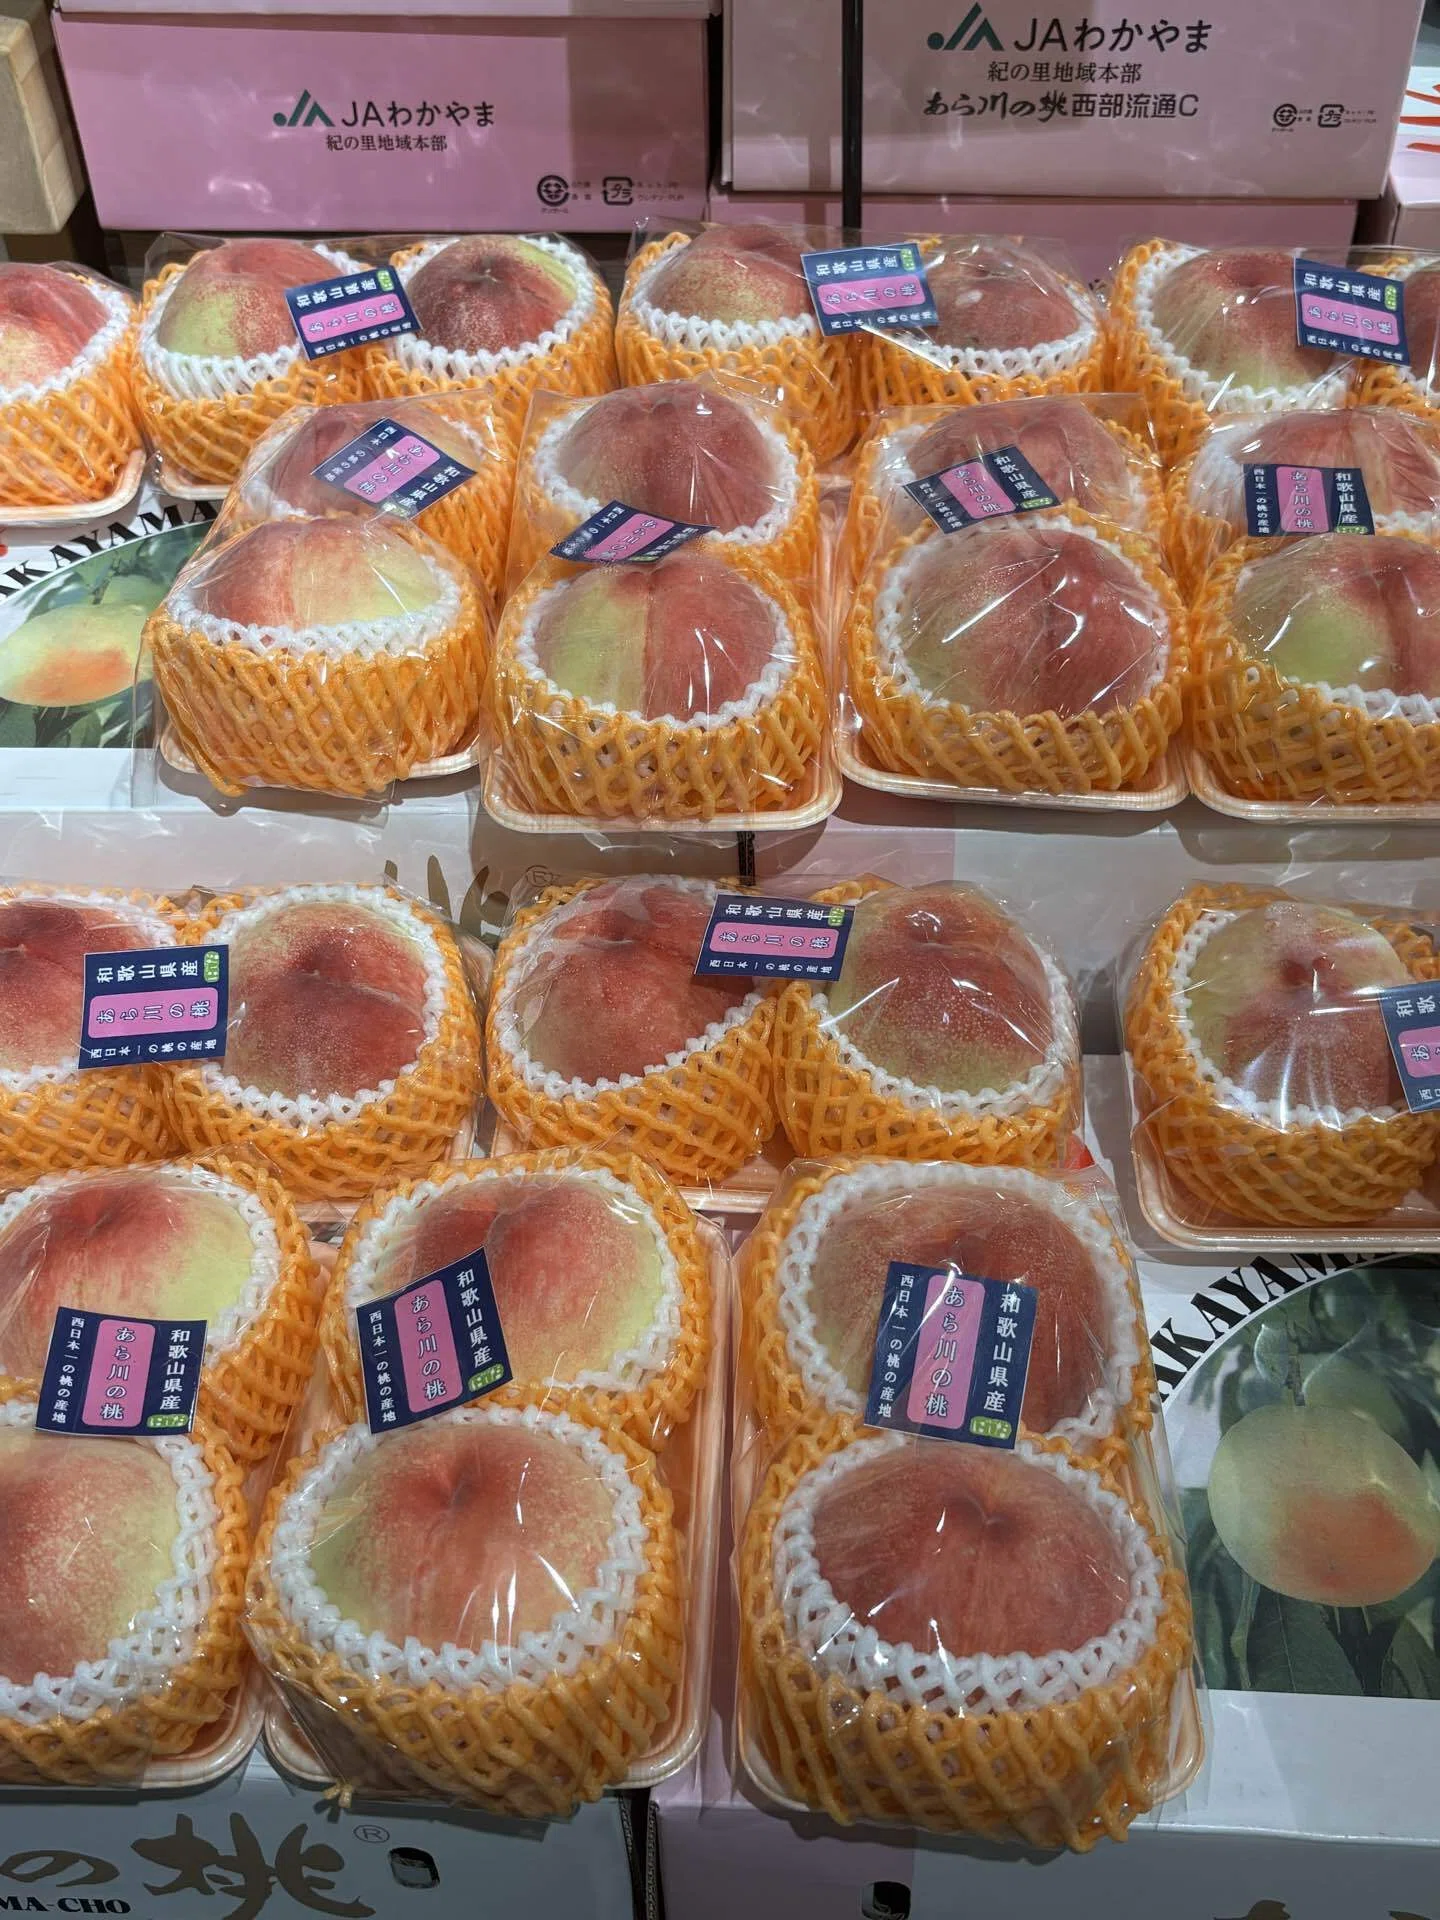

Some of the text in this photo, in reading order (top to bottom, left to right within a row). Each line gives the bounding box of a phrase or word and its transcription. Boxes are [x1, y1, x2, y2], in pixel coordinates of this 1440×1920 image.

[1013, 18, 1212, 53] JAわかやま
[987, 61, 1143, 84] 紀の里地域本部
[341, 101, 495, 127] JAわかやま
[326, 134, 448, 151] 紀の里地域本部
[816, 255, 899, 276] 和歌山県産
[296, 278, 378, 308] 和歌山県産
[825, 282, 918, 305] あら川の桃
[1303, 272, 1382, 302] 和歌山県産
[309, 301, 398, 333] あら川の桃
[1308, 305, 1395, 335] あら川の桃
[357, 444, 426, 496] あら川の桃
[994, 455, 1040, 499] 和歌山県産
[954, 468, 1003, 514] あら川の桃
[1291, 470, 1315, 530] あら川の桃
[1335, 472, 1359, 524] 和歌山県産
[0, 500, 218, 598] KAYAMA
[724, 903, 826, 921] 和歌山県産
[719, 931, 831, 950] あら川の桃
[96, 960, 199, 984] 和歌山県産
[709, 959, 833, 974] 西日本一の桃の産地
[96, 1000, 211, 1025] あら川の桃
[1396, 995, 1440, 1018] 和歌
[90, 1039, 217, 1060] 西日本一の桃の産地
[456, 1268, 493, 1369] 和歌山県産
[1151, 1252, 1397, 1402] KAYAM
[411, 1295, 448, 1401] あら川の桃
[876, 1274, 914, 1418] 西日本一の桃の産地
[925, 1286, 965, 1418] あら川の桃
[983, 1291, 1022, 1413] 和歌山県産
[52, 1316, 85, 1425] 西日本一の桃の産地
[100, 1327, 136, 1421] あら川の桃
[160, 1329, 191, 1411] 和歌山県産
[369, 1310, 396, 1424] 西日本一の桃の産地
